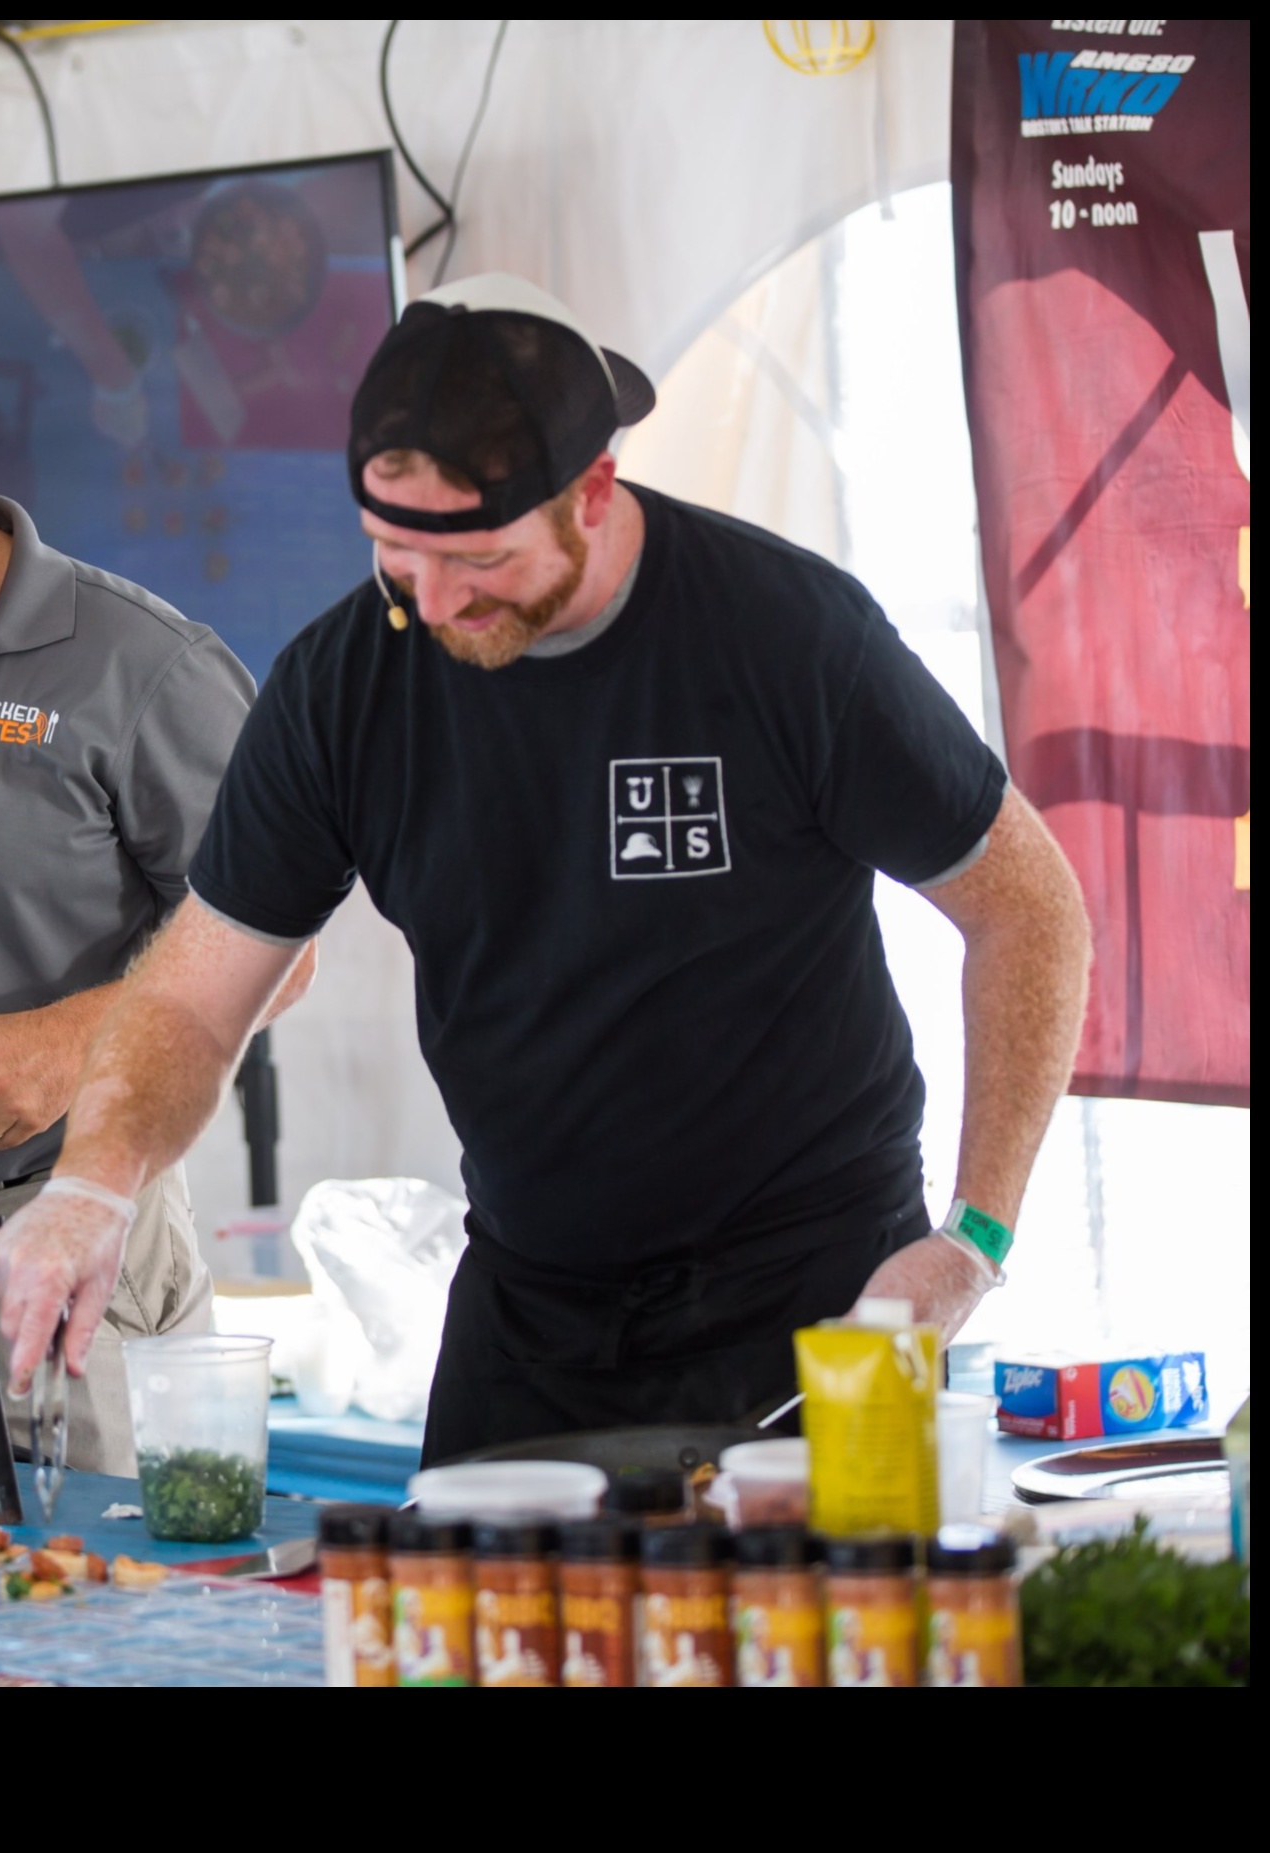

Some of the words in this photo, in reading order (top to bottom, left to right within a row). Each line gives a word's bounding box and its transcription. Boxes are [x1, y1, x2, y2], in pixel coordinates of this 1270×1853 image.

[1070, 49, 1196, 73] AM680
[1069, 115, 1093, 134] TALK
[1094, 114, 1154, 133] STATION
[1052, 155, 1125, 193] Sundays
[1049, 199, 1077, 230] 10
[1091, 201, 1139, 227] noon
[626, 776, 654, 811] U
[686, 826, 711, 859] S
[1003, 1366, 1044, 1395] Ziploc
